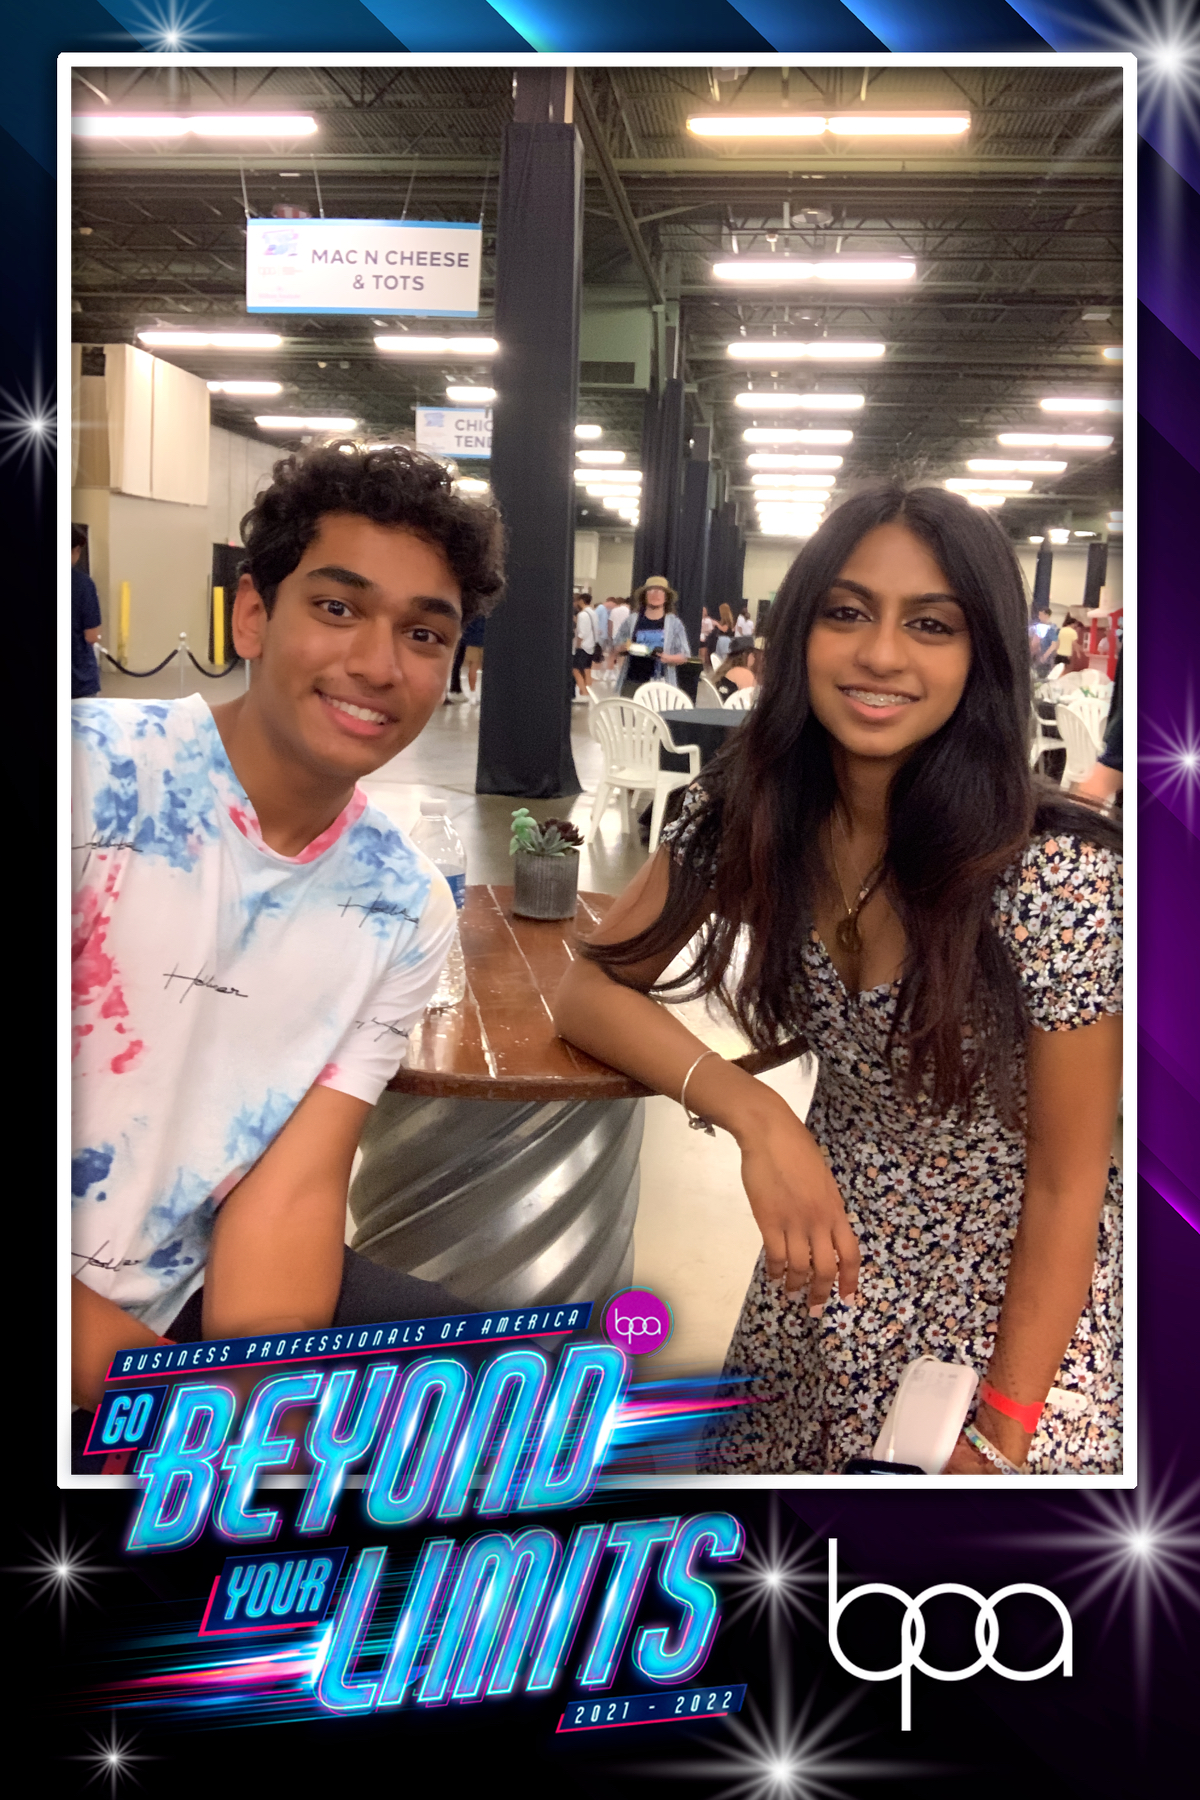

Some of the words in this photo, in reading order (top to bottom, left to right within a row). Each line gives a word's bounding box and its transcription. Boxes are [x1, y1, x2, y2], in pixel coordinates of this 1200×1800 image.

[311, 249, 358, 264] MAC
[365, 251, 378, 265] N
[385, 250, 470, 268] CHEESE
[352, 274, 365, 290] &
[372, 274, 425, 291] TOTS
